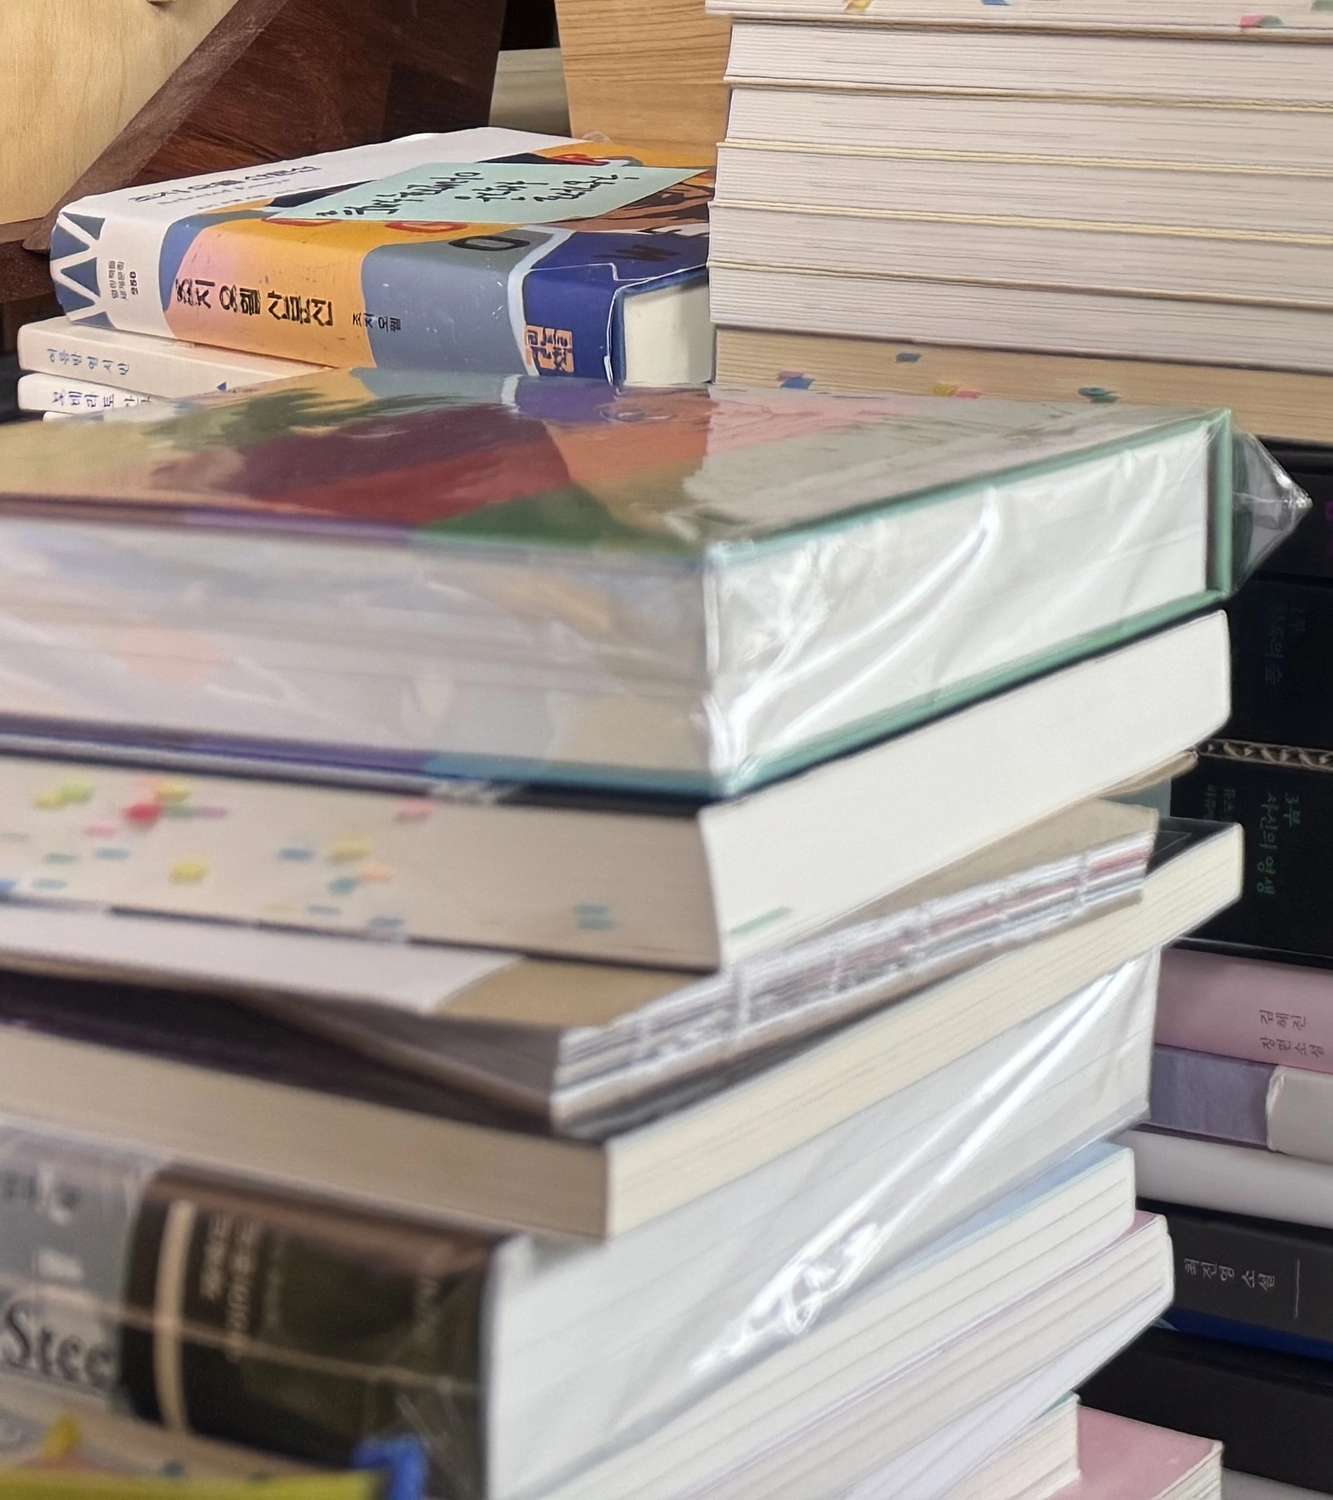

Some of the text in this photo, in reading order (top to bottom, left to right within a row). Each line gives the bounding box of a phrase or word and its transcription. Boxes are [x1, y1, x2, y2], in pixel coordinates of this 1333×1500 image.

[129, 271, 139, 296] 256
[174, 277, 334, 328] 조지 오웰 산문선
[1284, 792, 1303, 828] 3부
[1255, 790, 1279, 897] 사신의 영생
[1258, 1008, 1308, 1032] 김혜진
[1259, 1034, 1326, 1058] 장편소설
[1183, 1257, 1277, 1293] 최진영 소설
